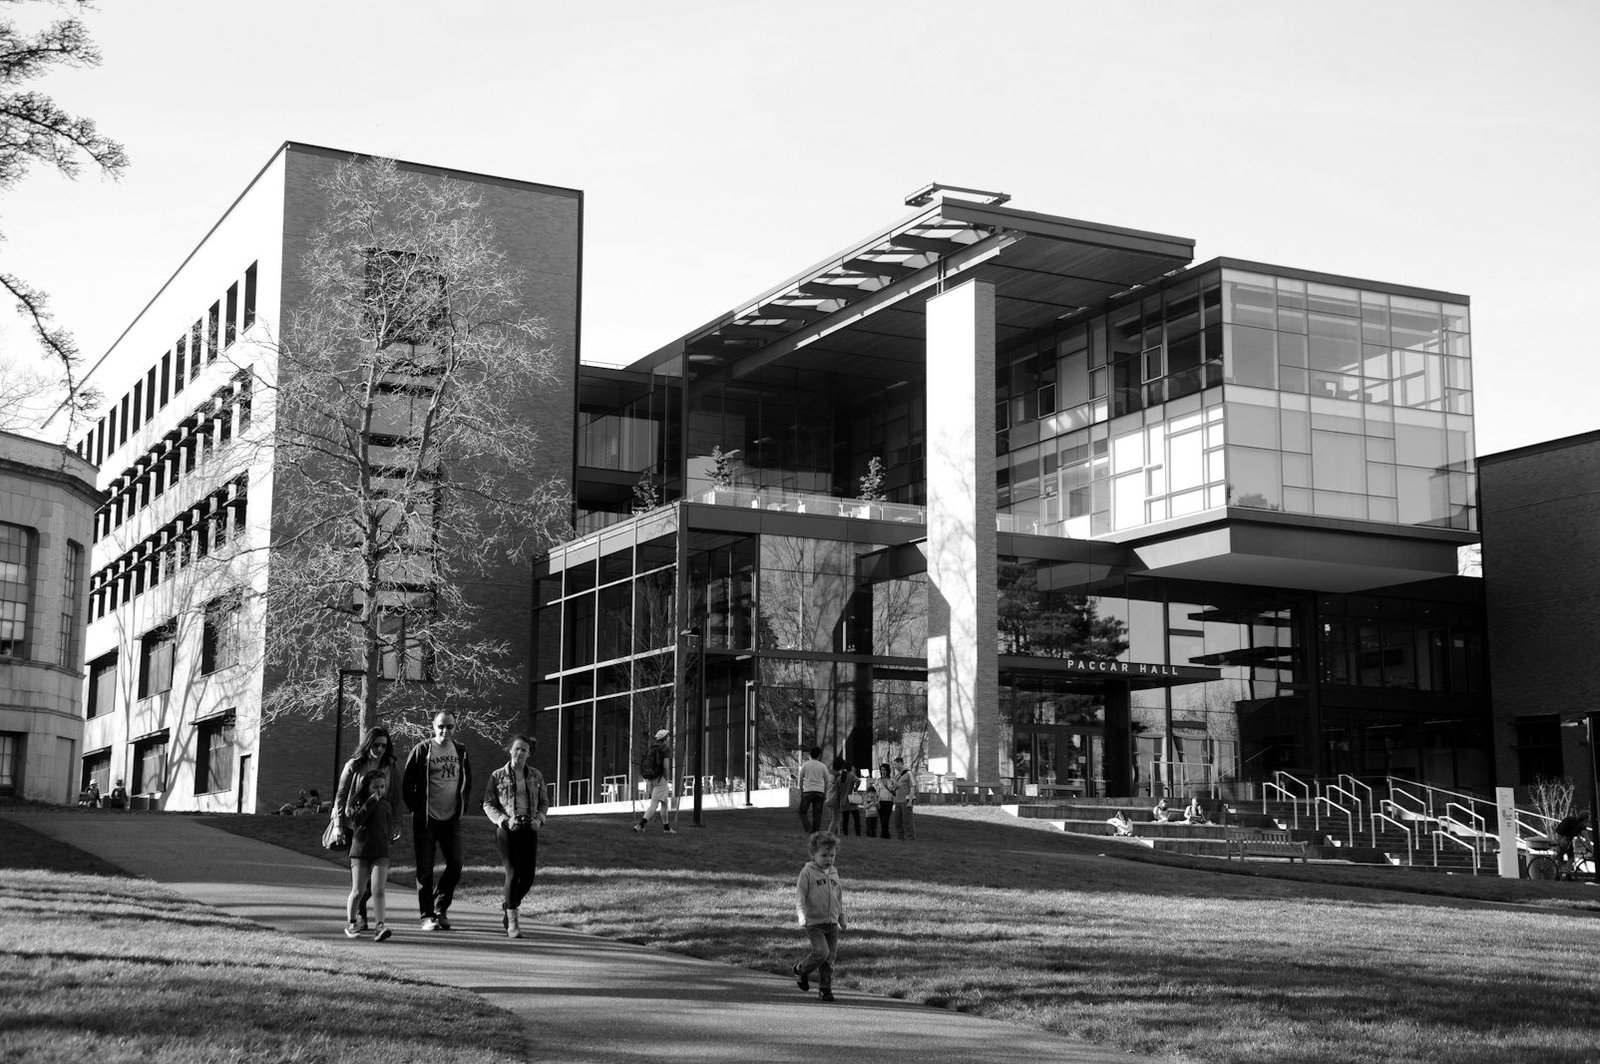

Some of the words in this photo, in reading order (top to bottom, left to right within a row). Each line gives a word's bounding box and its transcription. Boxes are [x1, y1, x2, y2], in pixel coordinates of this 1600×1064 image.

[1067, 660, 1129, 672] PACCAR
[1139, 664, 1179, 675] HALL
[430, 755, 460, 765] YANKEE
